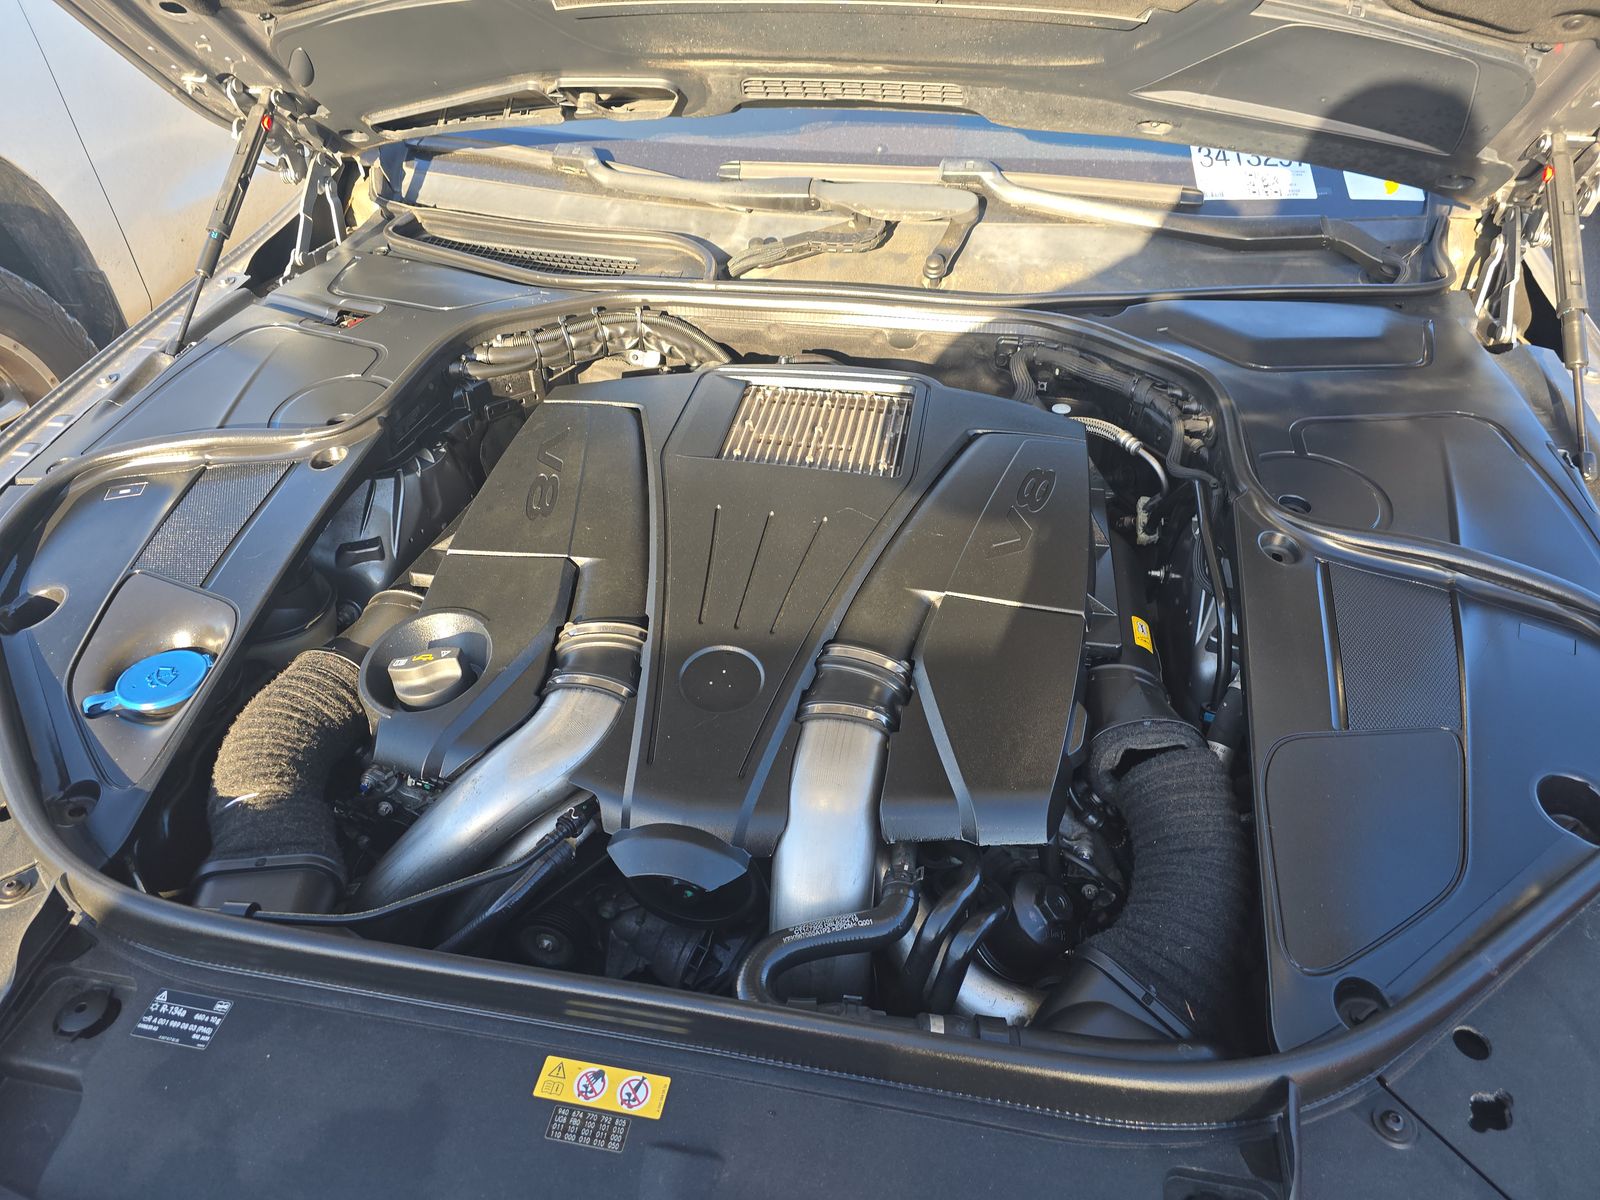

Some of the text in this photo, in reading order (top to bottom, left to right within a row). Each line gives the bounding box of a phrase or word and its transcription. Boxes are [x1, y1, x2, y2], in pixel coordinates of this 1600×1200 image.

[526, 430, 568, 520] V8
[985, 467, 1057, 560] V8
[160, 1004, 187, 1017] R-134a
[158, 1018, 169, 1026] 001
[566, 1125, 578, 1133] 101
[583, 1120, 595, 1128] 100
[598, 1123, 609, 1131] 101
[549, 1130, 561, 1138] 110
[592, 1138, 604, 1146] 010
